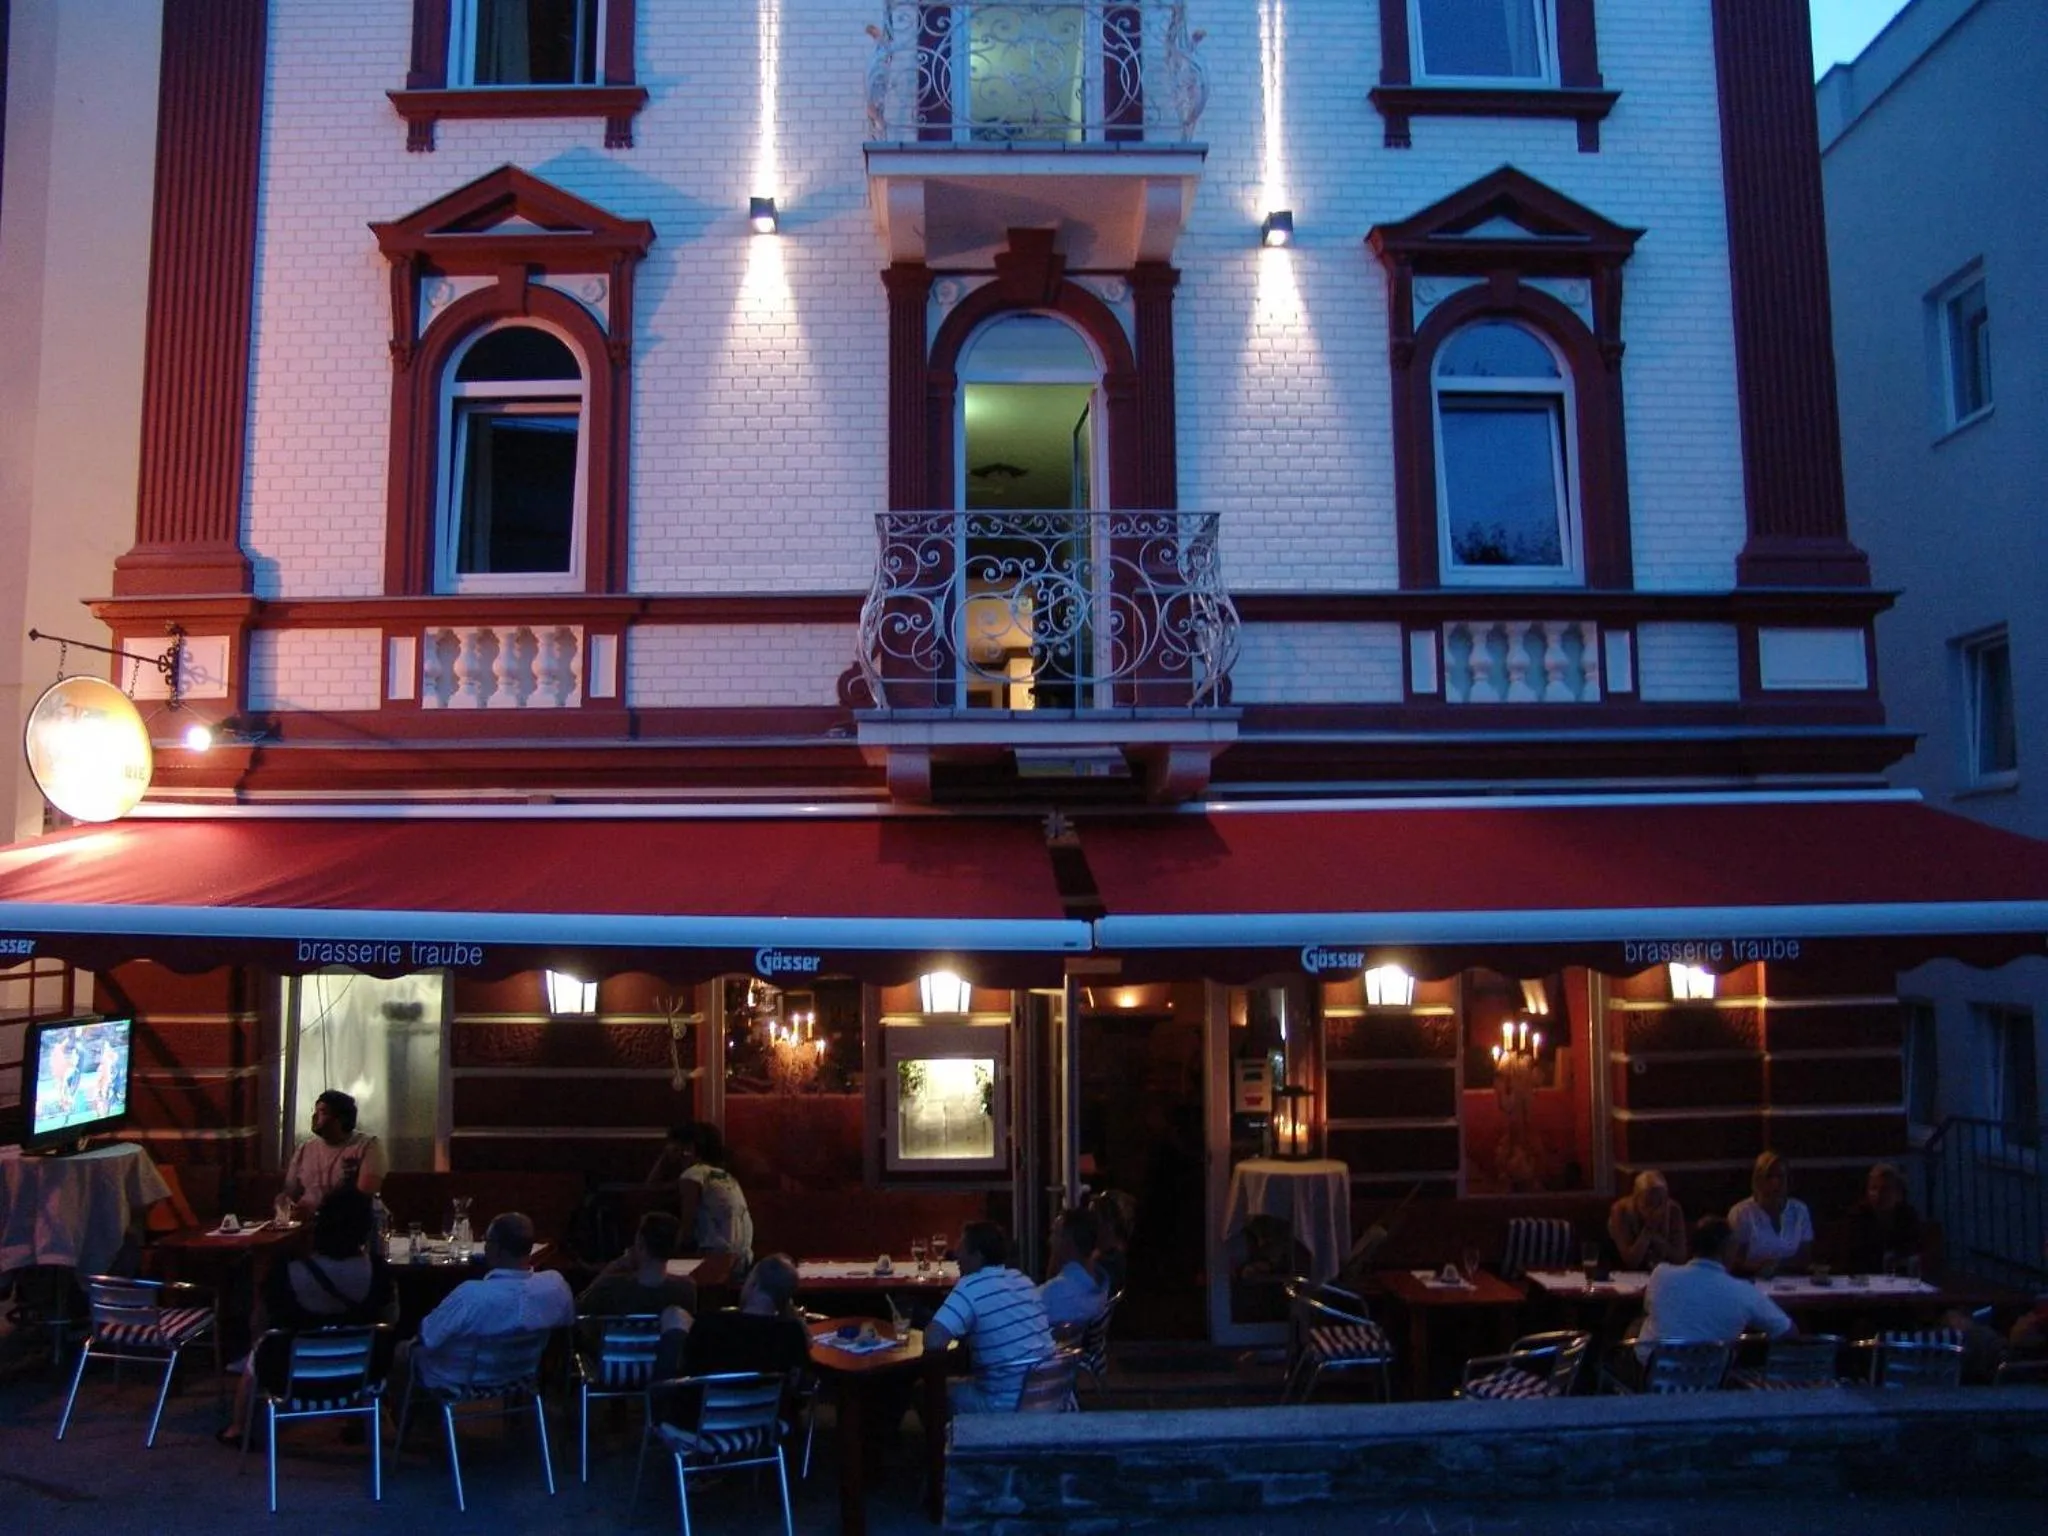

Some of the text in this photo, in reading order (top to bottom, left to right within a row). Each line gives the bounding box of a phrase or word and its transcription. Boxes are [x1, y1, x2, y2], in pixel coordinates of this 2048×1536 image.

[298, 939, 483, 966] brasserie traube
[755, 948, 821, 977] Gösser
[1301, 946, 1365, 974] Gösser
[1625, 937, 1800, 963] brasserie traube
